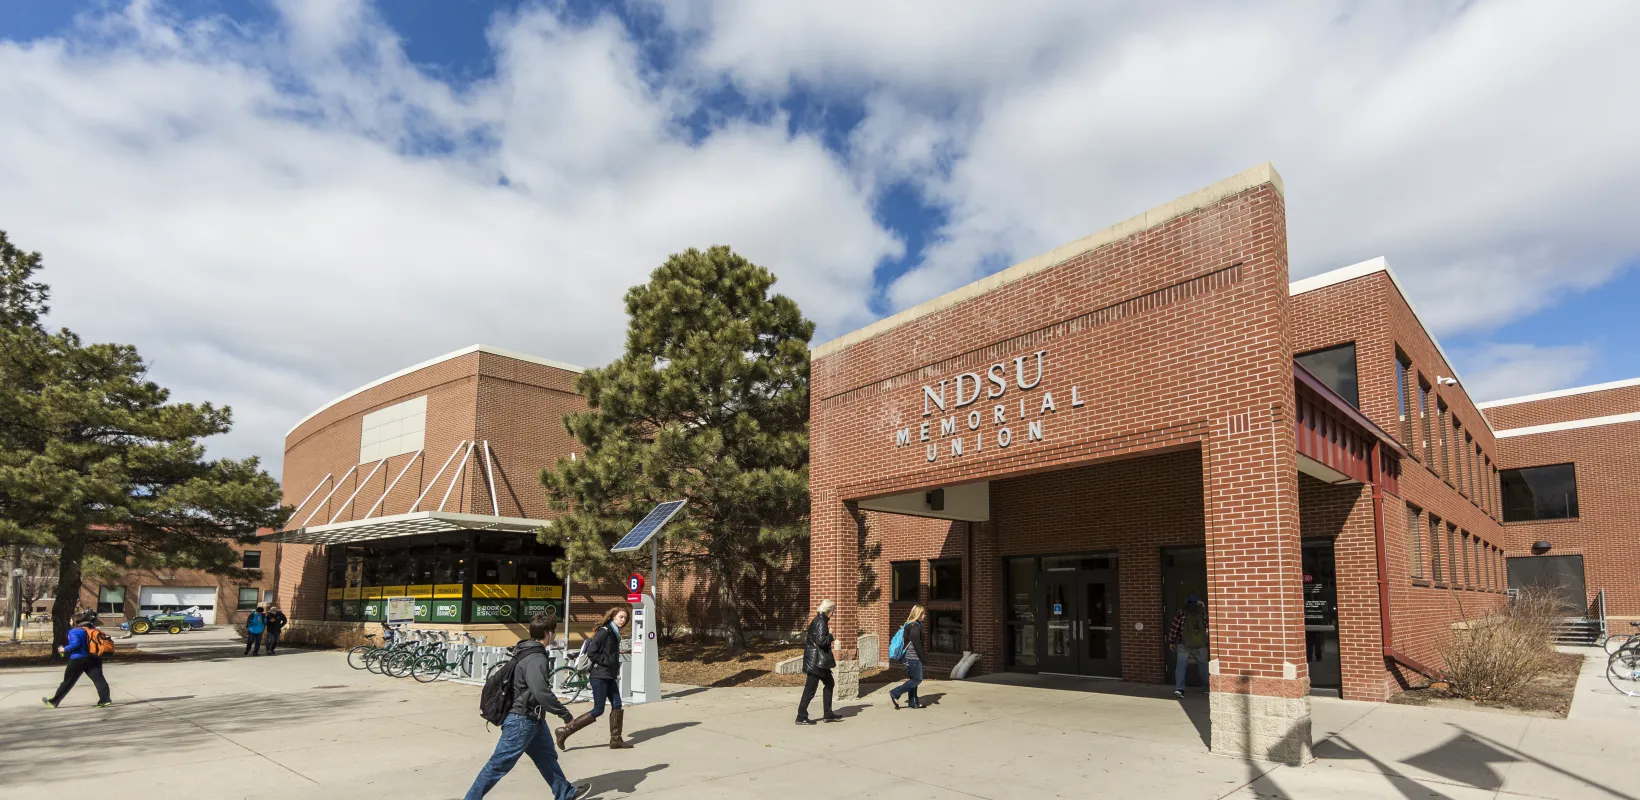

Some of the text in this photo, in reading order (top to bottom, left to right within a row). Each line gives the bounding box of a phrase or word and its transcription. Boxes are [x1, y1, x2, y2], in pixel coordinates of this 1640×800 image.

[922, 350, 1047, 417] NDSU
[897, 386, 1085, 448] MEMORIAL
[926, 419, 1043, 462] UNION
[631, 579, 638, 589] B
